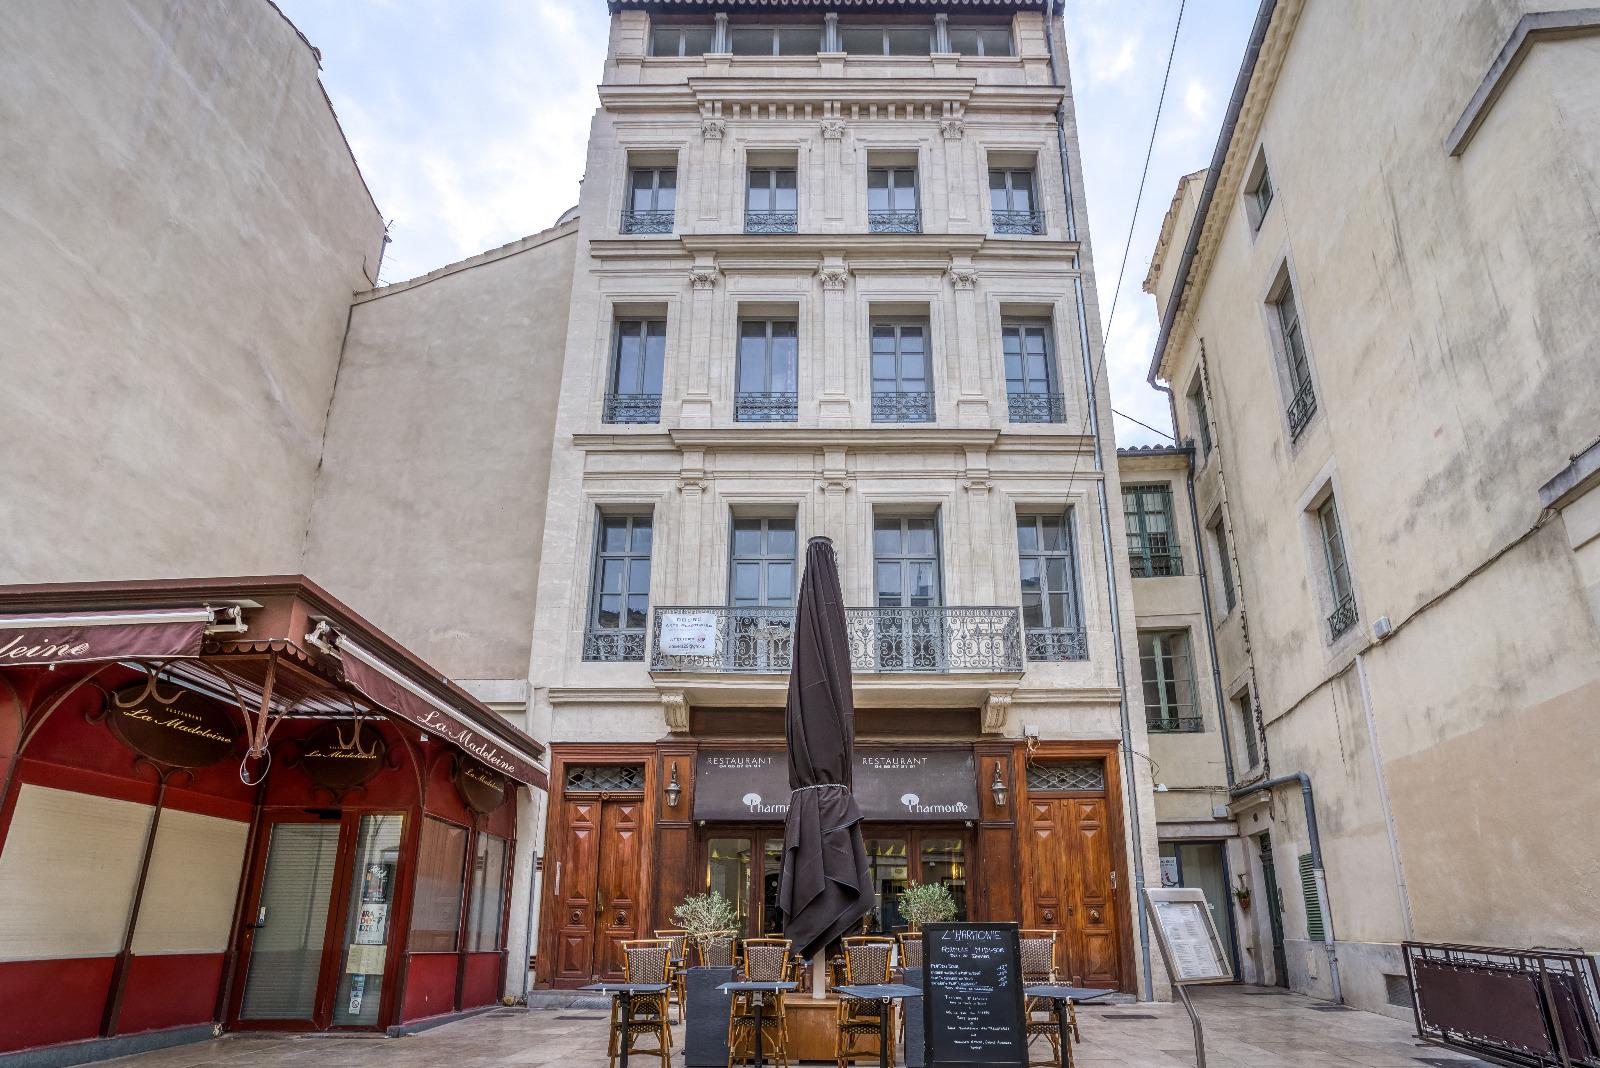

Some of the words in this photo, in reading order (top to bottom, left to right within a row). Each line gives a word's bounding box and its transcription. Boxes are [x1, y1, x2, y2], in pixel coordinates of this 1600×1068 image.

[122, 708, 153, 722] La
[154, 718, 232, 743] Madeleine
[417, 710, 448, 734] La
[448, 729, 515, 773] Madeleine
[707, 757, 773, 765] RESTAURANT
[862, 757, 928, 765] RESTAURANT
